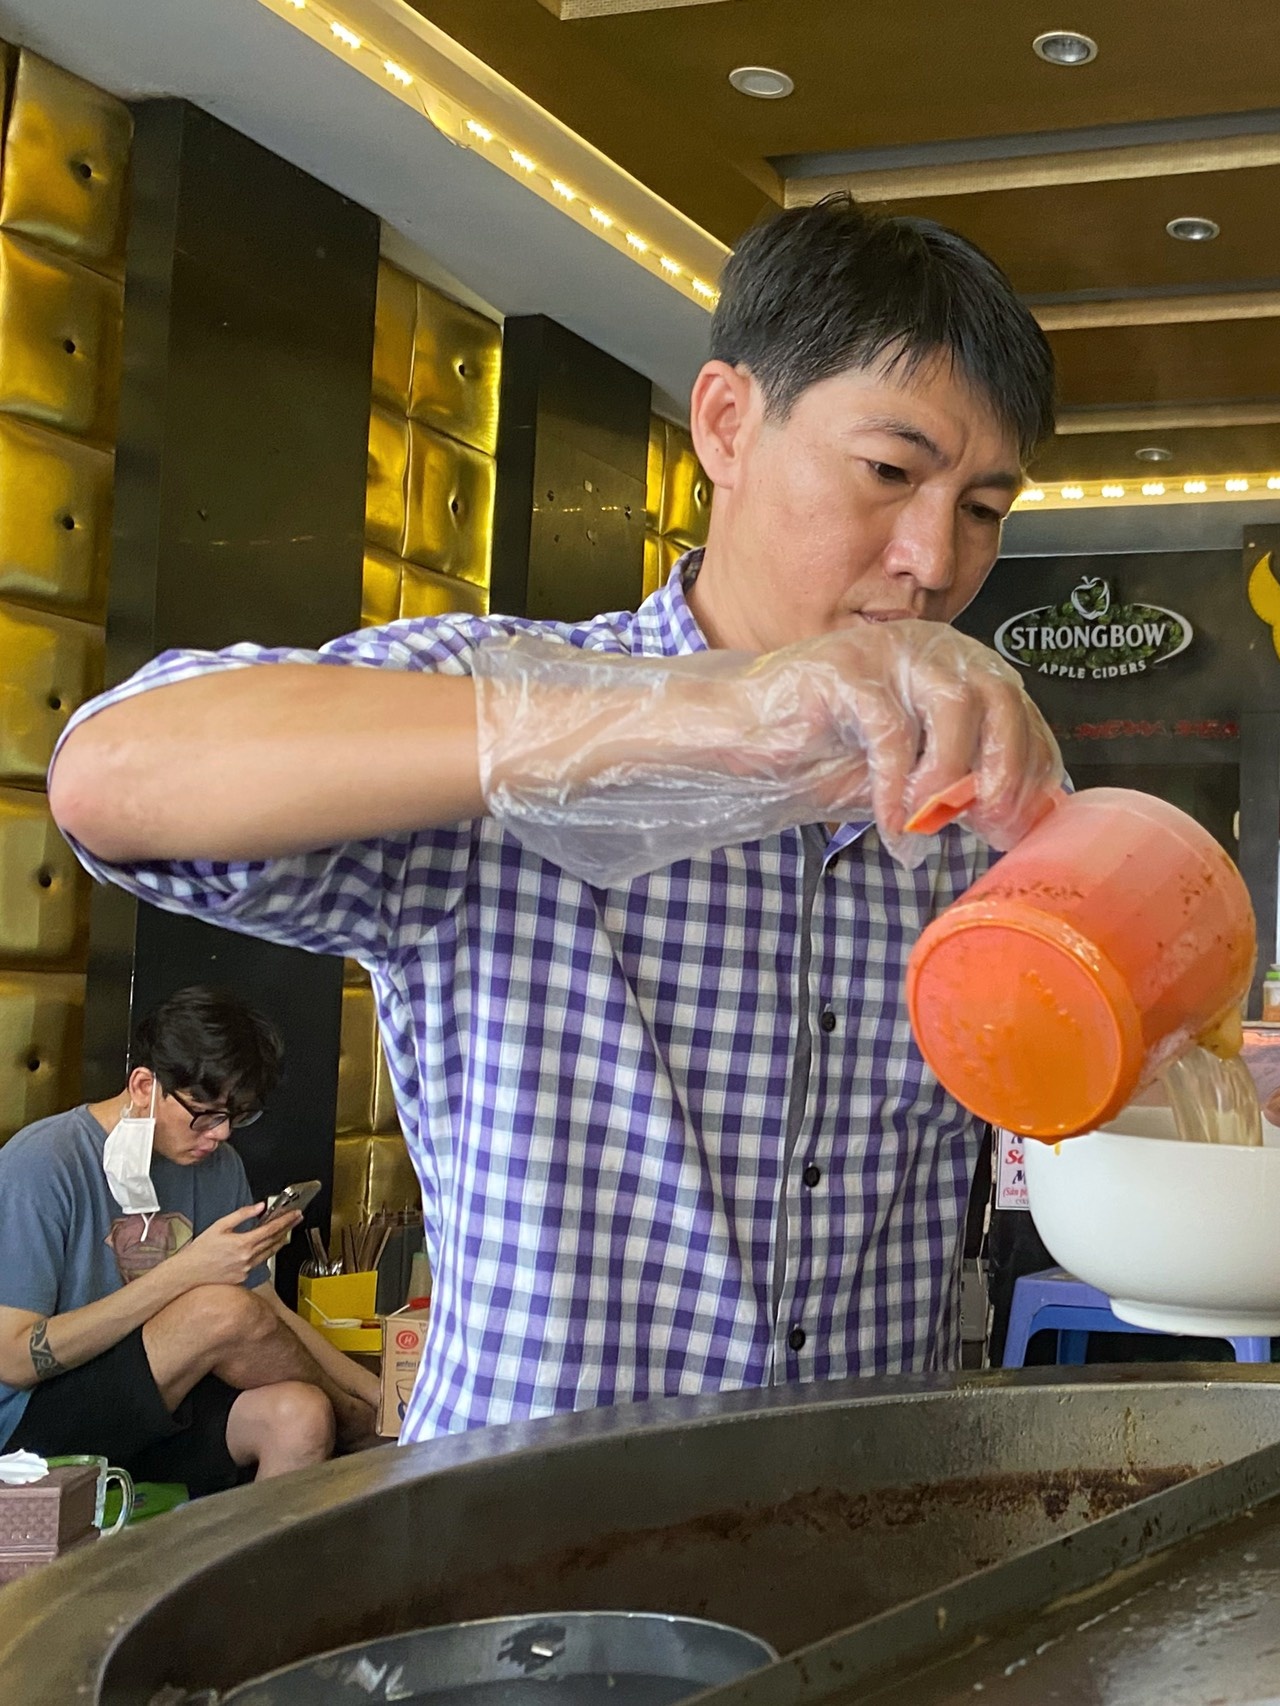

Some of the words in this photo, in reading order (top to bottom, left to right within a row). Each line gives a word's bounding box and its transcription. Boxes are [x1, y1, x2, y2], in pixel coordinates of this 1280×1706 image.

[1010, 622, 1167, 650] STRONGBOW
[1038, 662, 1086, 679] APPLE
[1092, 659, 1147, 679] CIDERS
